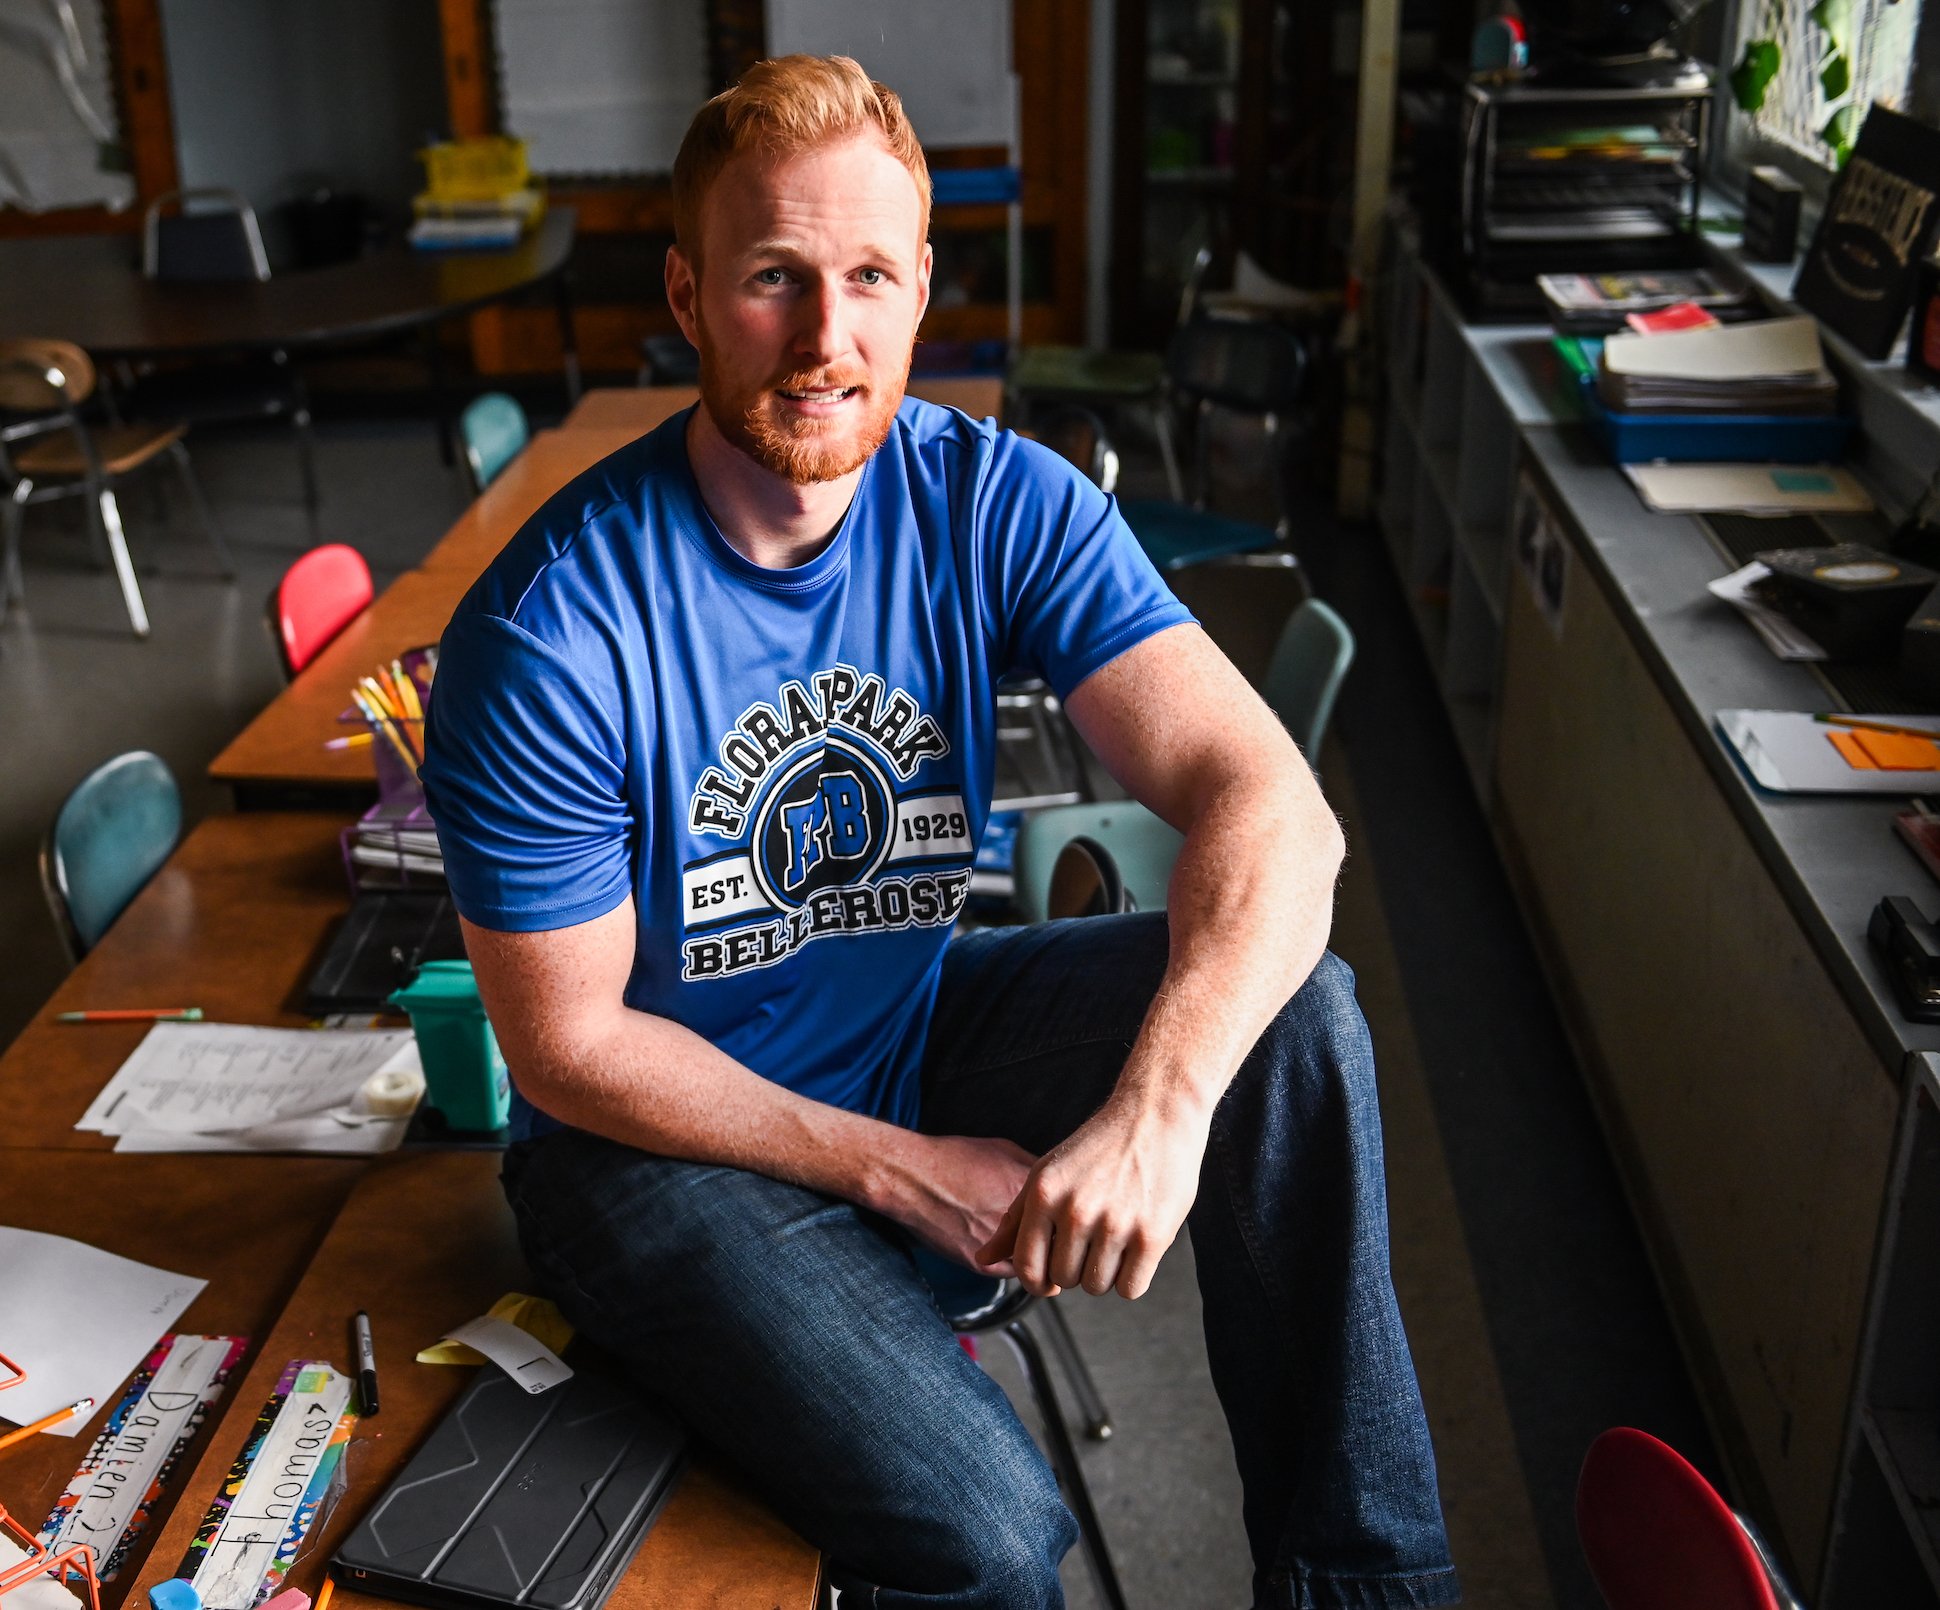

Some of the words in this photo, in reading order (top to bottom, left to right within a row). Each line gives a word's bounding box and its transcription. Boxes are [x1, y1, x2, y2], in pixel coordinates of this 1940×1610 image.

[830, 662, 950, 782] PARK
[691, 875, 749, 910] EST.
[902, 813, 966, 842] 1929
[682, 867, 973, 982] BELLEROSE
[89, 1391, 199, 1500] Damien
[211, 1419, 332, 1556] Thomas
